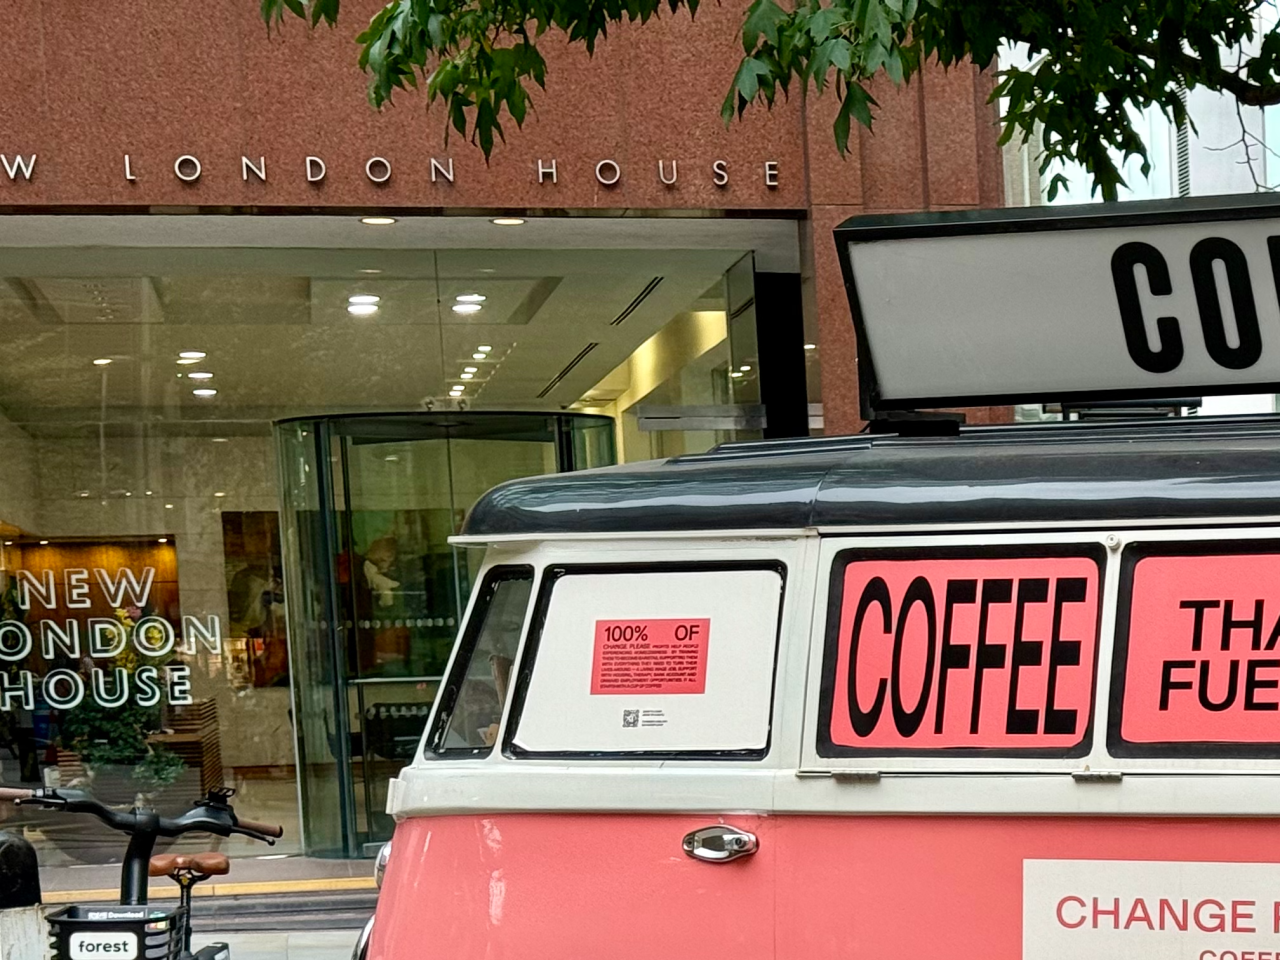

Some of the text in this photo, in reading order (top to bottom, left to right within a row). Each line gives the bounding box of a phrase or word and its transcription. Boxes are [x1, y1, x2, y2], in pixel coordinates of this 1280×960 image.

[0, 154, 779, 187] W LONDON HOUSE
[16, 566, 156, 610] NEW
[0, 615, 222, 662] ONDON
[604, 624, 700, 642] 100% OF
[847, 574, 1088, 740] COFFEE
[0, 665, 193, 711] HOUSE
[1056, 894, 1256, 934] CHANGE
[78, 940, 129, 953] forest
